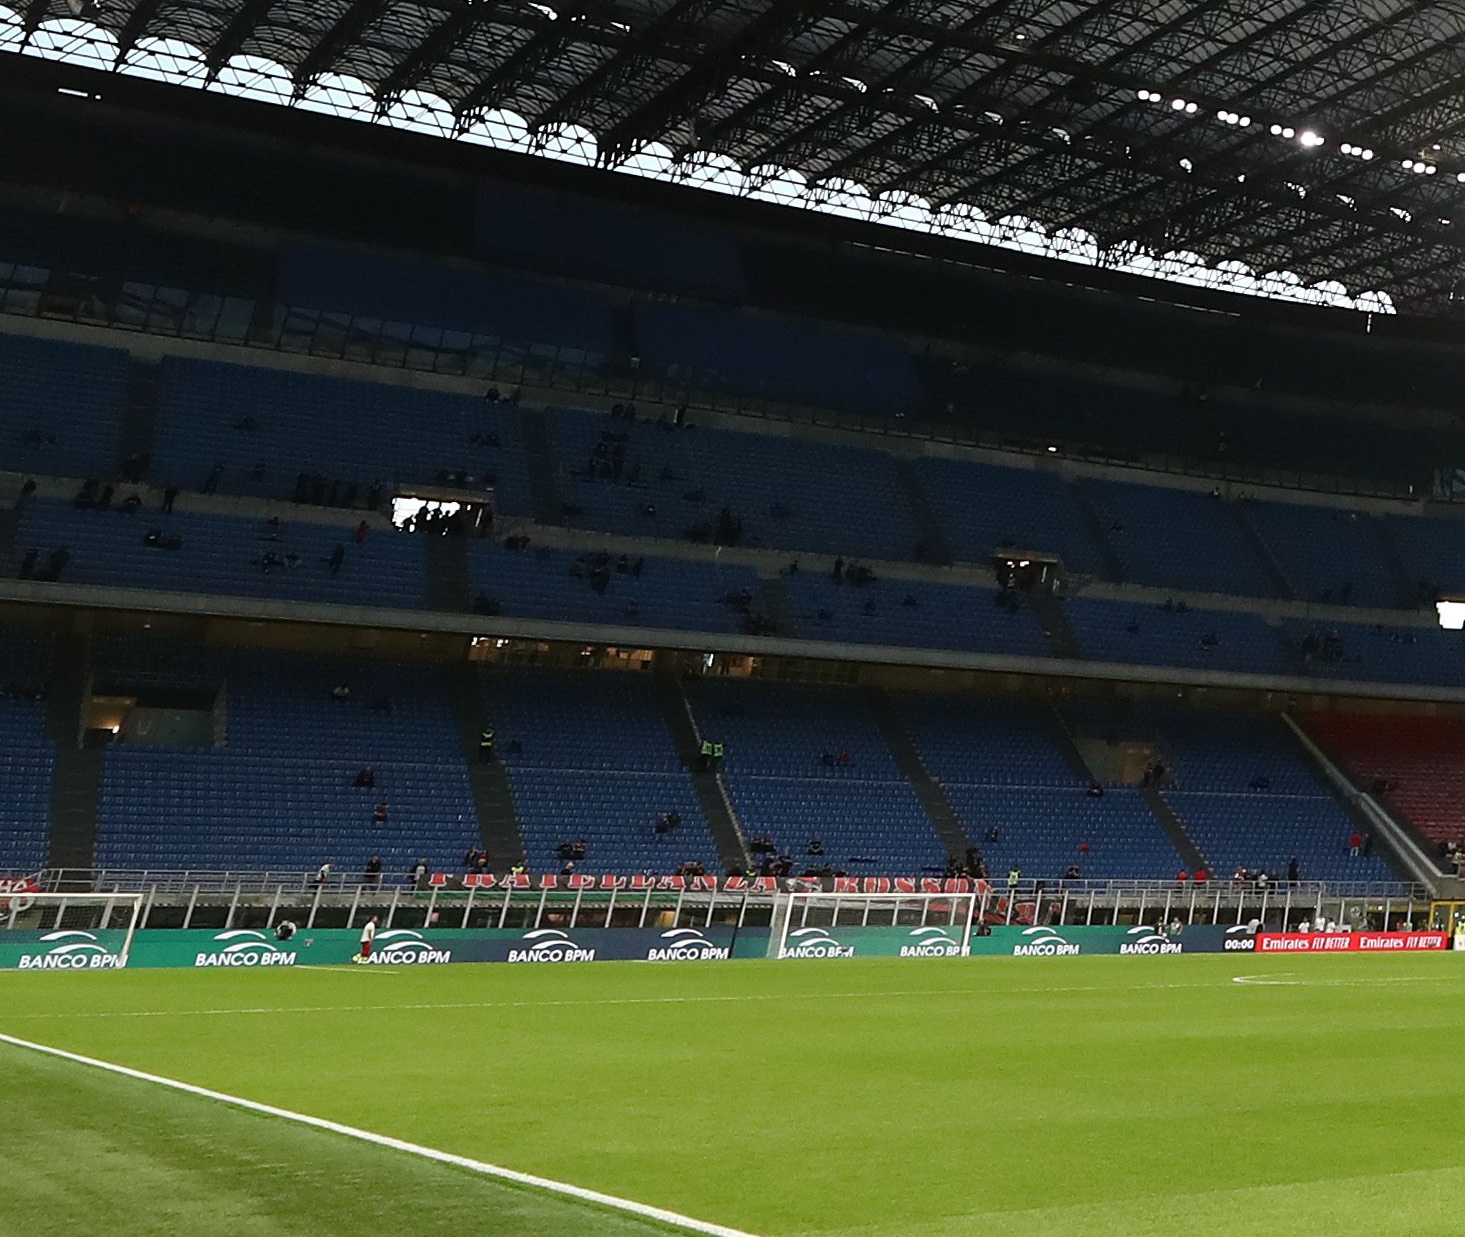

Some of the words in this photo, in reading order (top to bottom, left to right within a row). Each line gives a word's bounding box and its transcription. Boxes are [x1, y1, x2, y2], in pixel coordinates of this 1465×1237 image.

[1120, 943, 1158, 954] BANCO
[1160, 943, 1182, 954] BPM
[1225, 939, 1254, 950] 00:00
[1262, 936, 1309, 951] Emirates
[1360, 936, 1404, 949] Emirates
[417, 950, 451, 964] BPM
[508, 950, 561, 963] BANCO
[564, 949, 595, 963] BPM
[648, 949, 698, 962] BANCO
[700, 948, 729, 960] BPM
[900, 945, 944, 957] BANCO
[1013, 944, 1054, 956] BANCO
[1056, 944, 1080, 955] BPM
[19, 953, 87, 969] BANCO
[195, 953, 258, 966] BANCO
[261, 952, 296, 966] BPM
